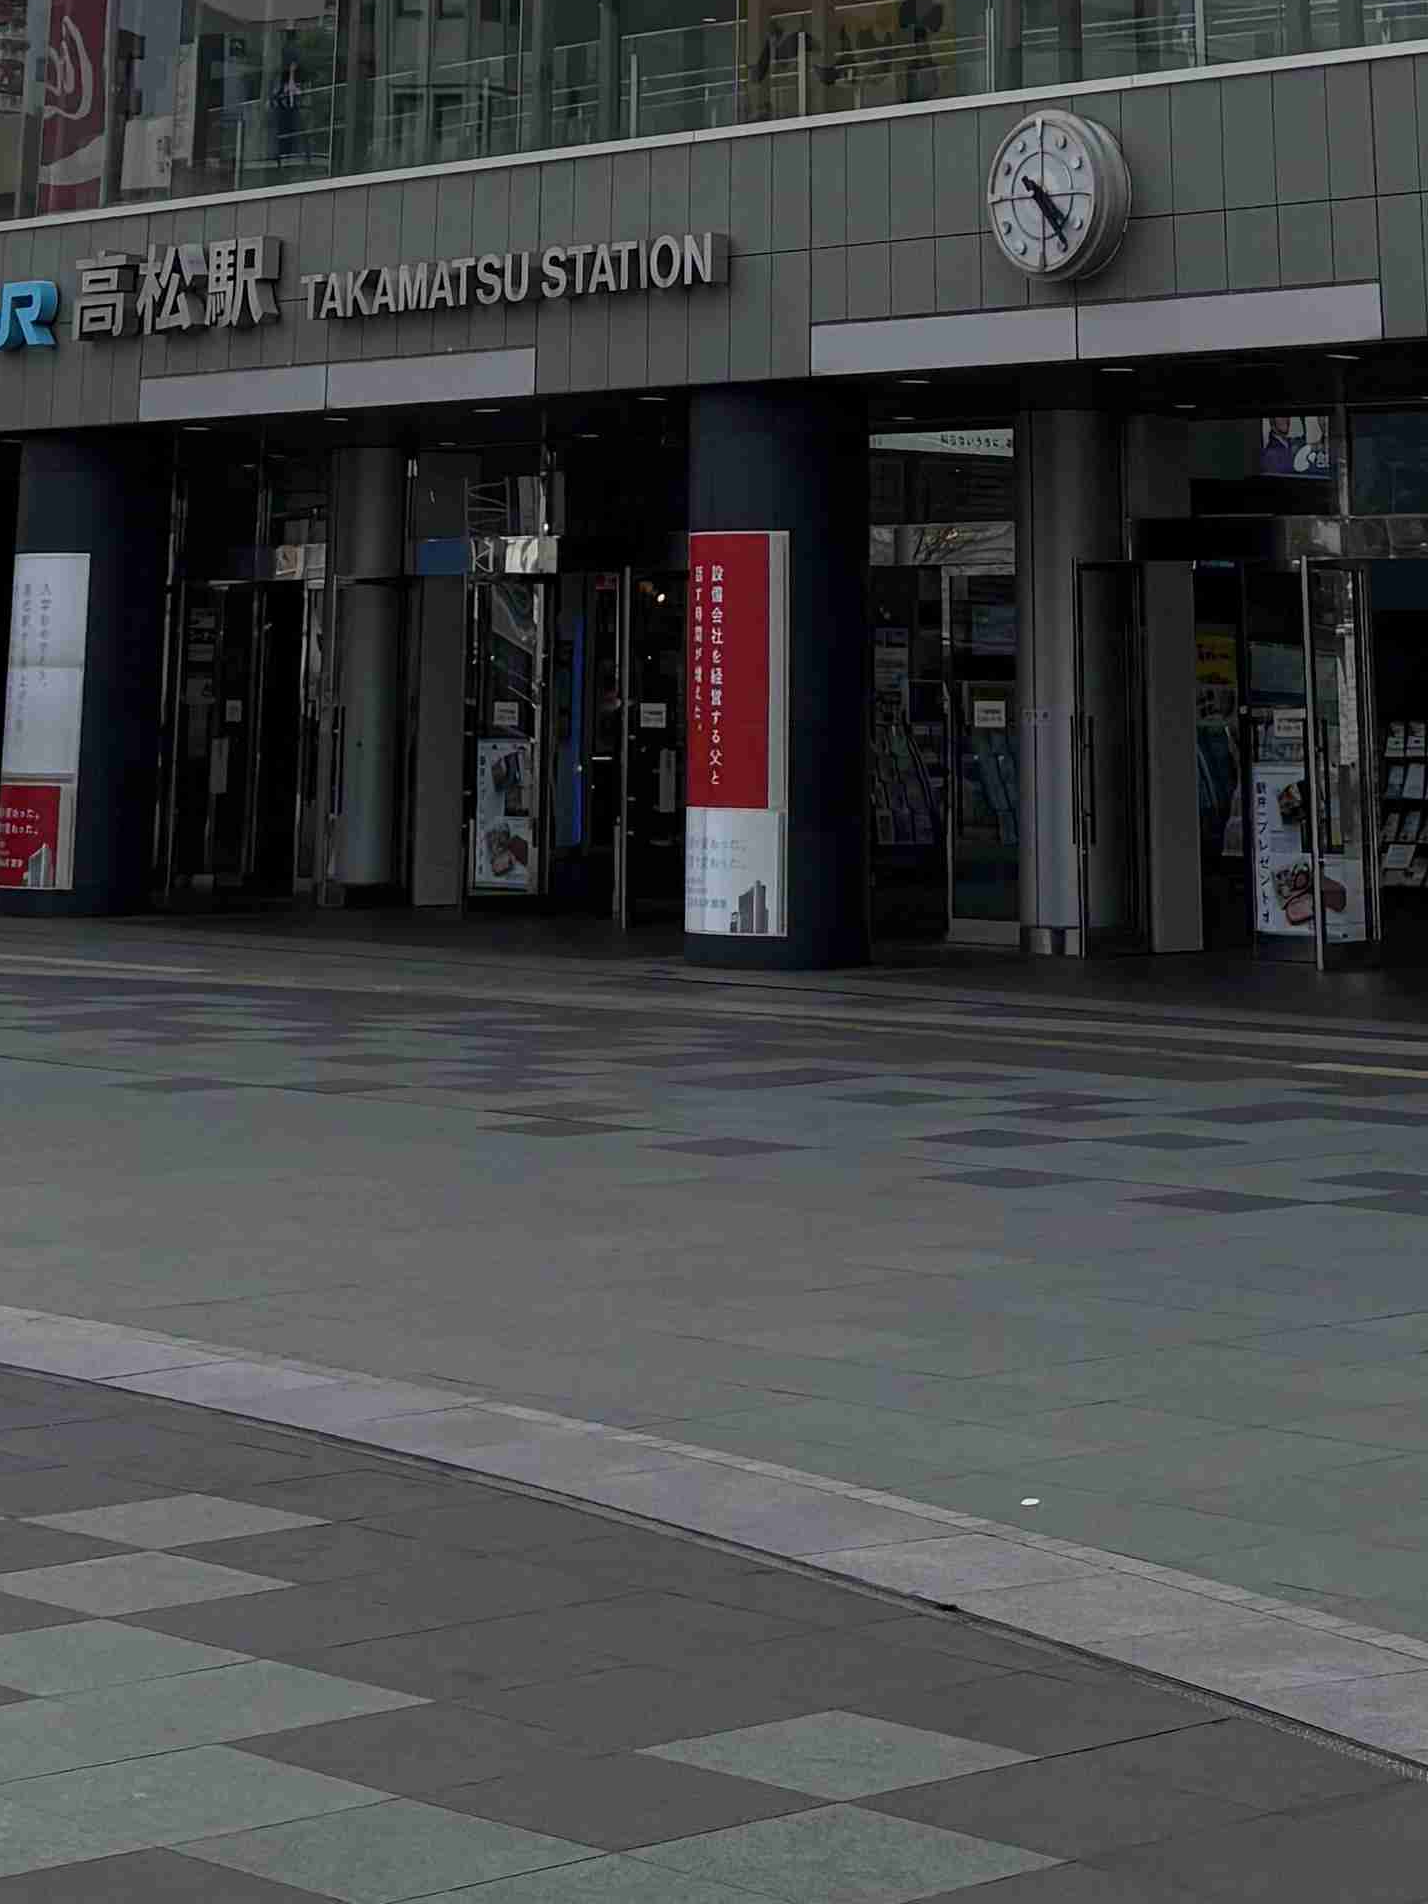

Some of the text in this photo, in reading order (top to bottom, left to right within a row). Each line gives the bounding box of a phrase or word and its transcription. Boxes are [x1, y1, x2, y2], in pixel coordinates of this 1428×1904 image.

[73, 236, 281, 341] 高松駅
[299, 232, 721, 320] TAKAMATSU STATION
